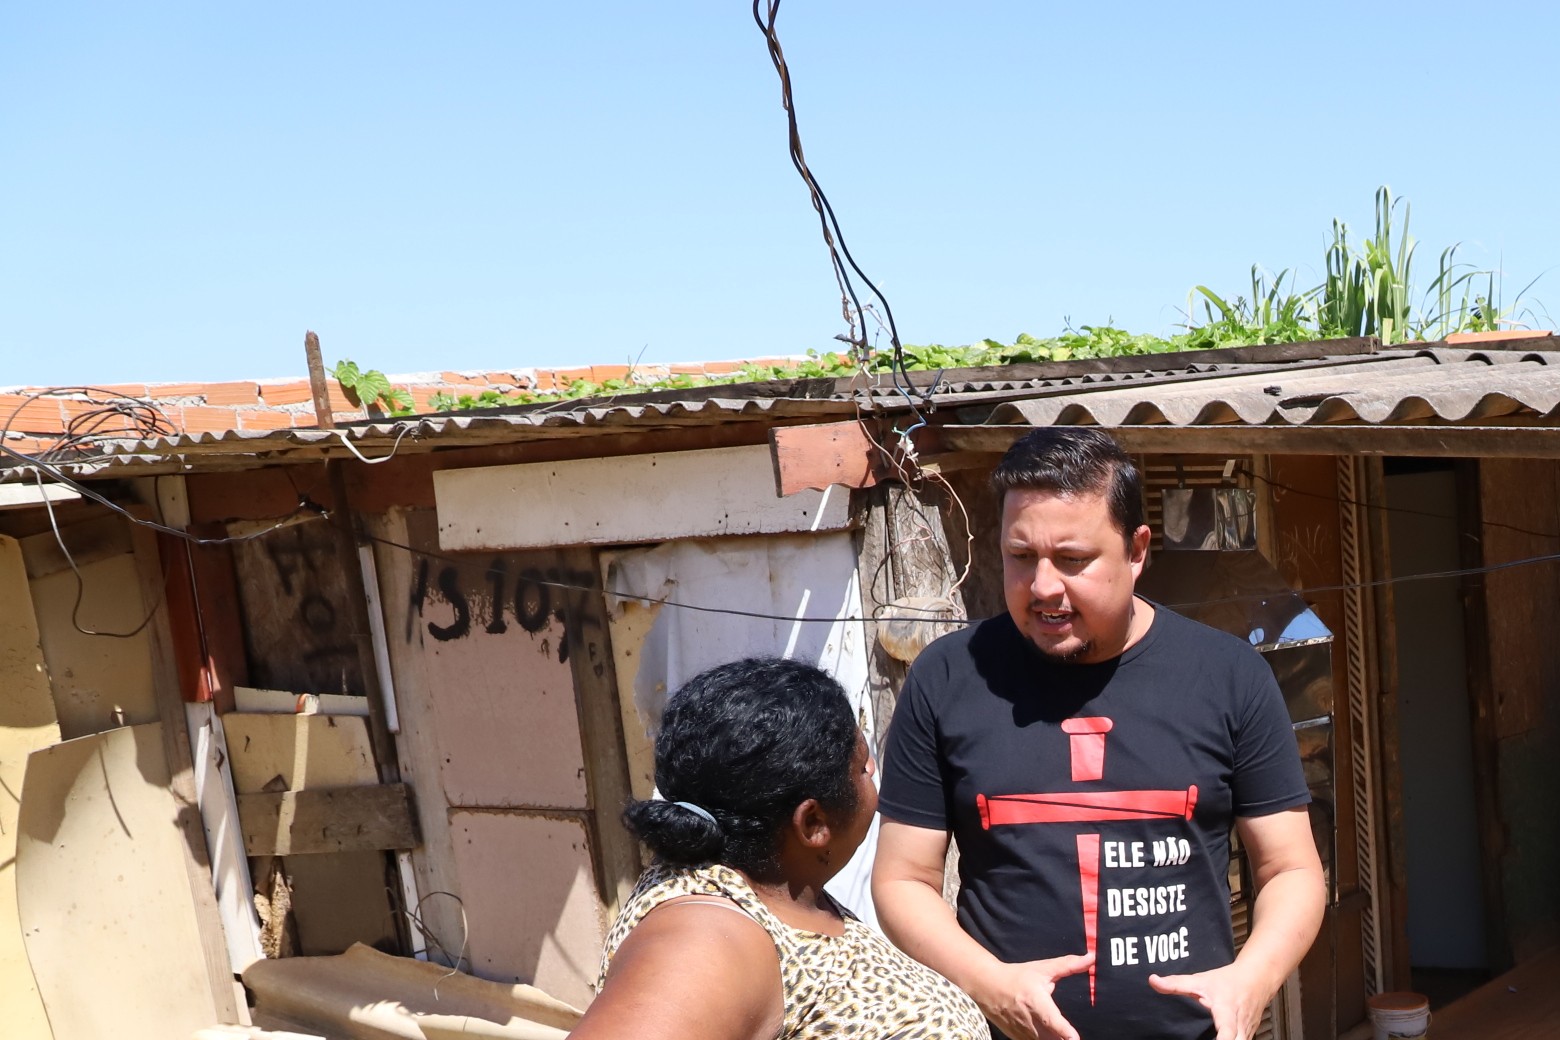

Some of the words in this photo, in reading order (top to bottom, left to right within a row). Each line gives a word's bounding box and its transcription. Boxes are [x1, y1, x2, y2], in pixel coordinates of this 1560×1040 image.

[1104, 841, 1145, 868] ELE
[1152, 836, 1191, 867] NÃO
[1106, 883, 1187, 917] DESISTE
[1110, 936, 1139, 966] DE
[1144, 926, 1190, 964] VOCÊ
